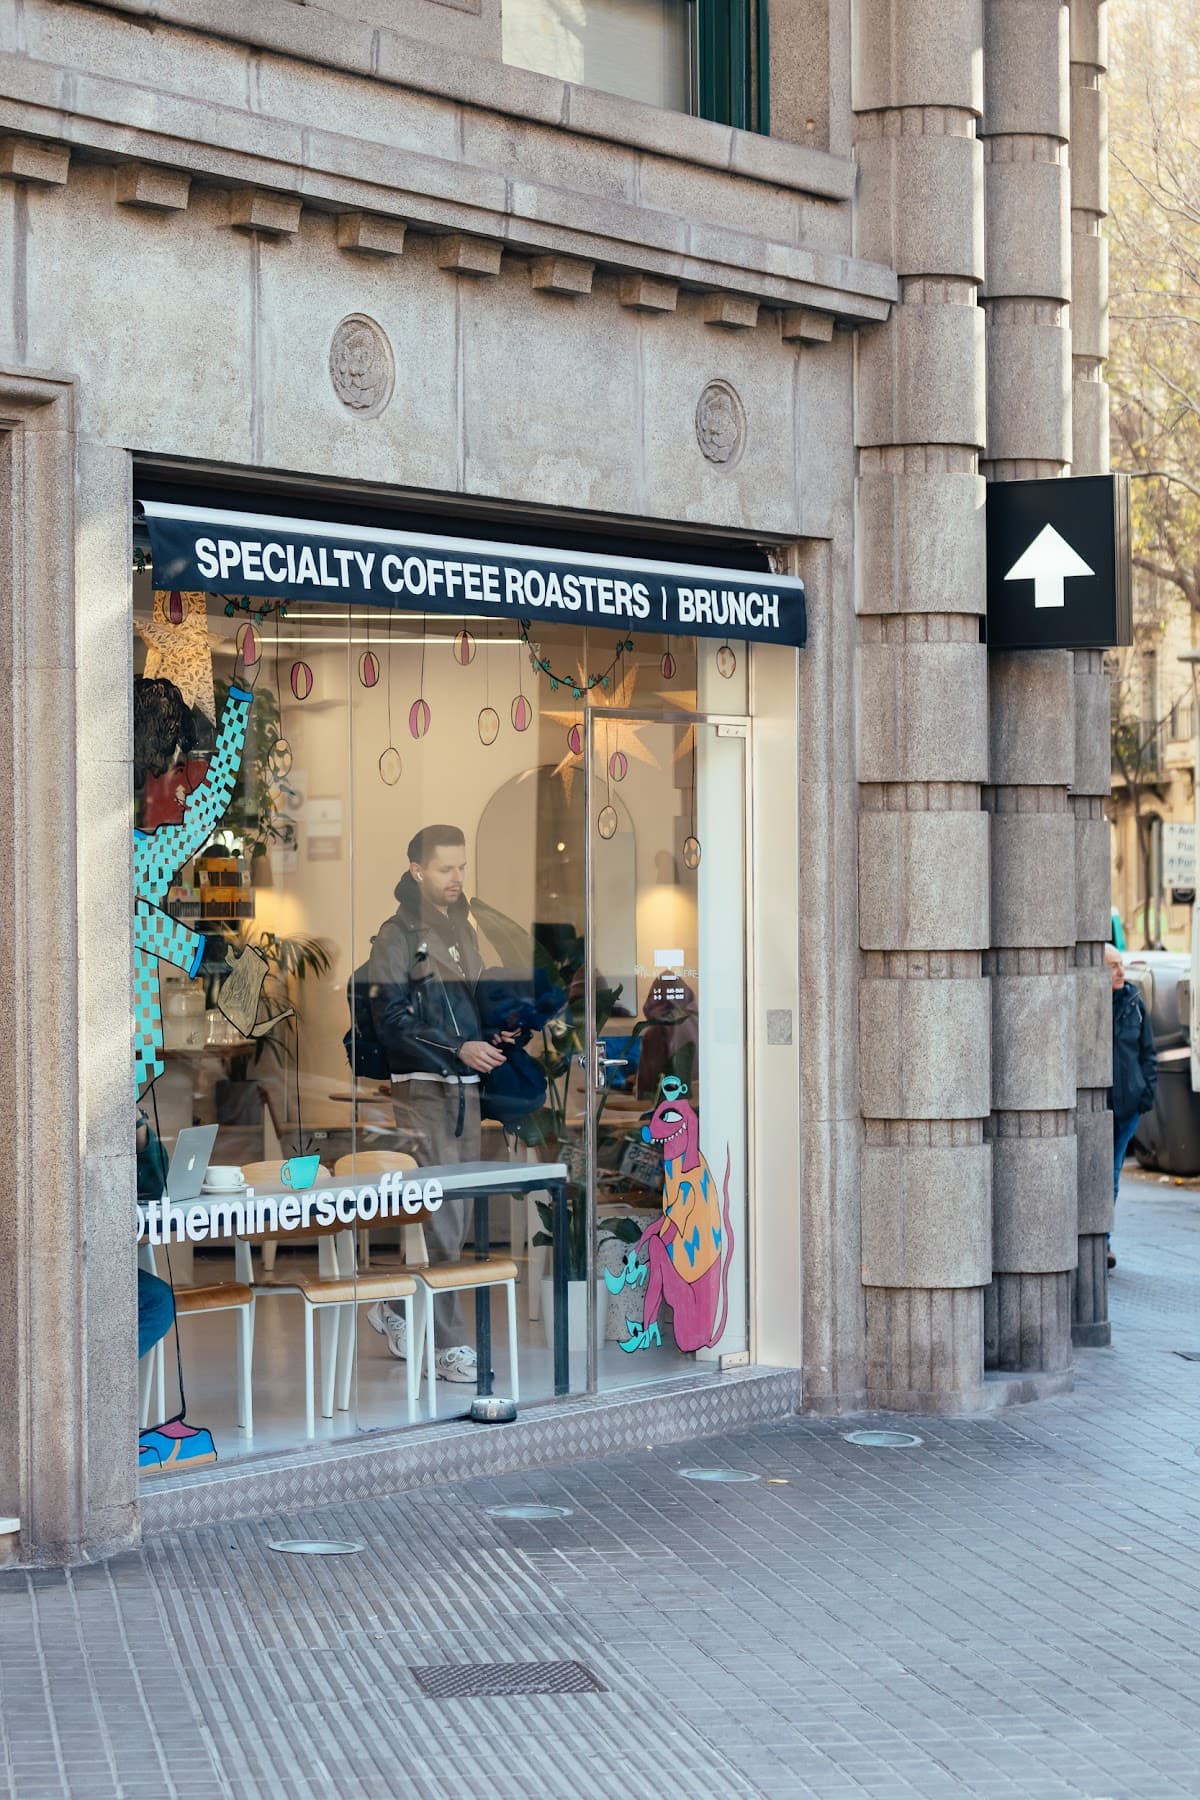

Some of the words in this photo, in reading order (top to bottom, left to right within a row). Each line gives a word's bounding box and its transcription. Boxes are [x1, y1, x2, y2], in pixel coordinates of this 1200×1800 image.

[194, 537, 376, 590] SPECIALTY
[381, 554, 501, 602] COFFEE
[504, 567, 650, 619] ROASTERS
[677, 587, 780, 628] BRUNCH
[137, 1171, 443, 1246] theminerscoffee
